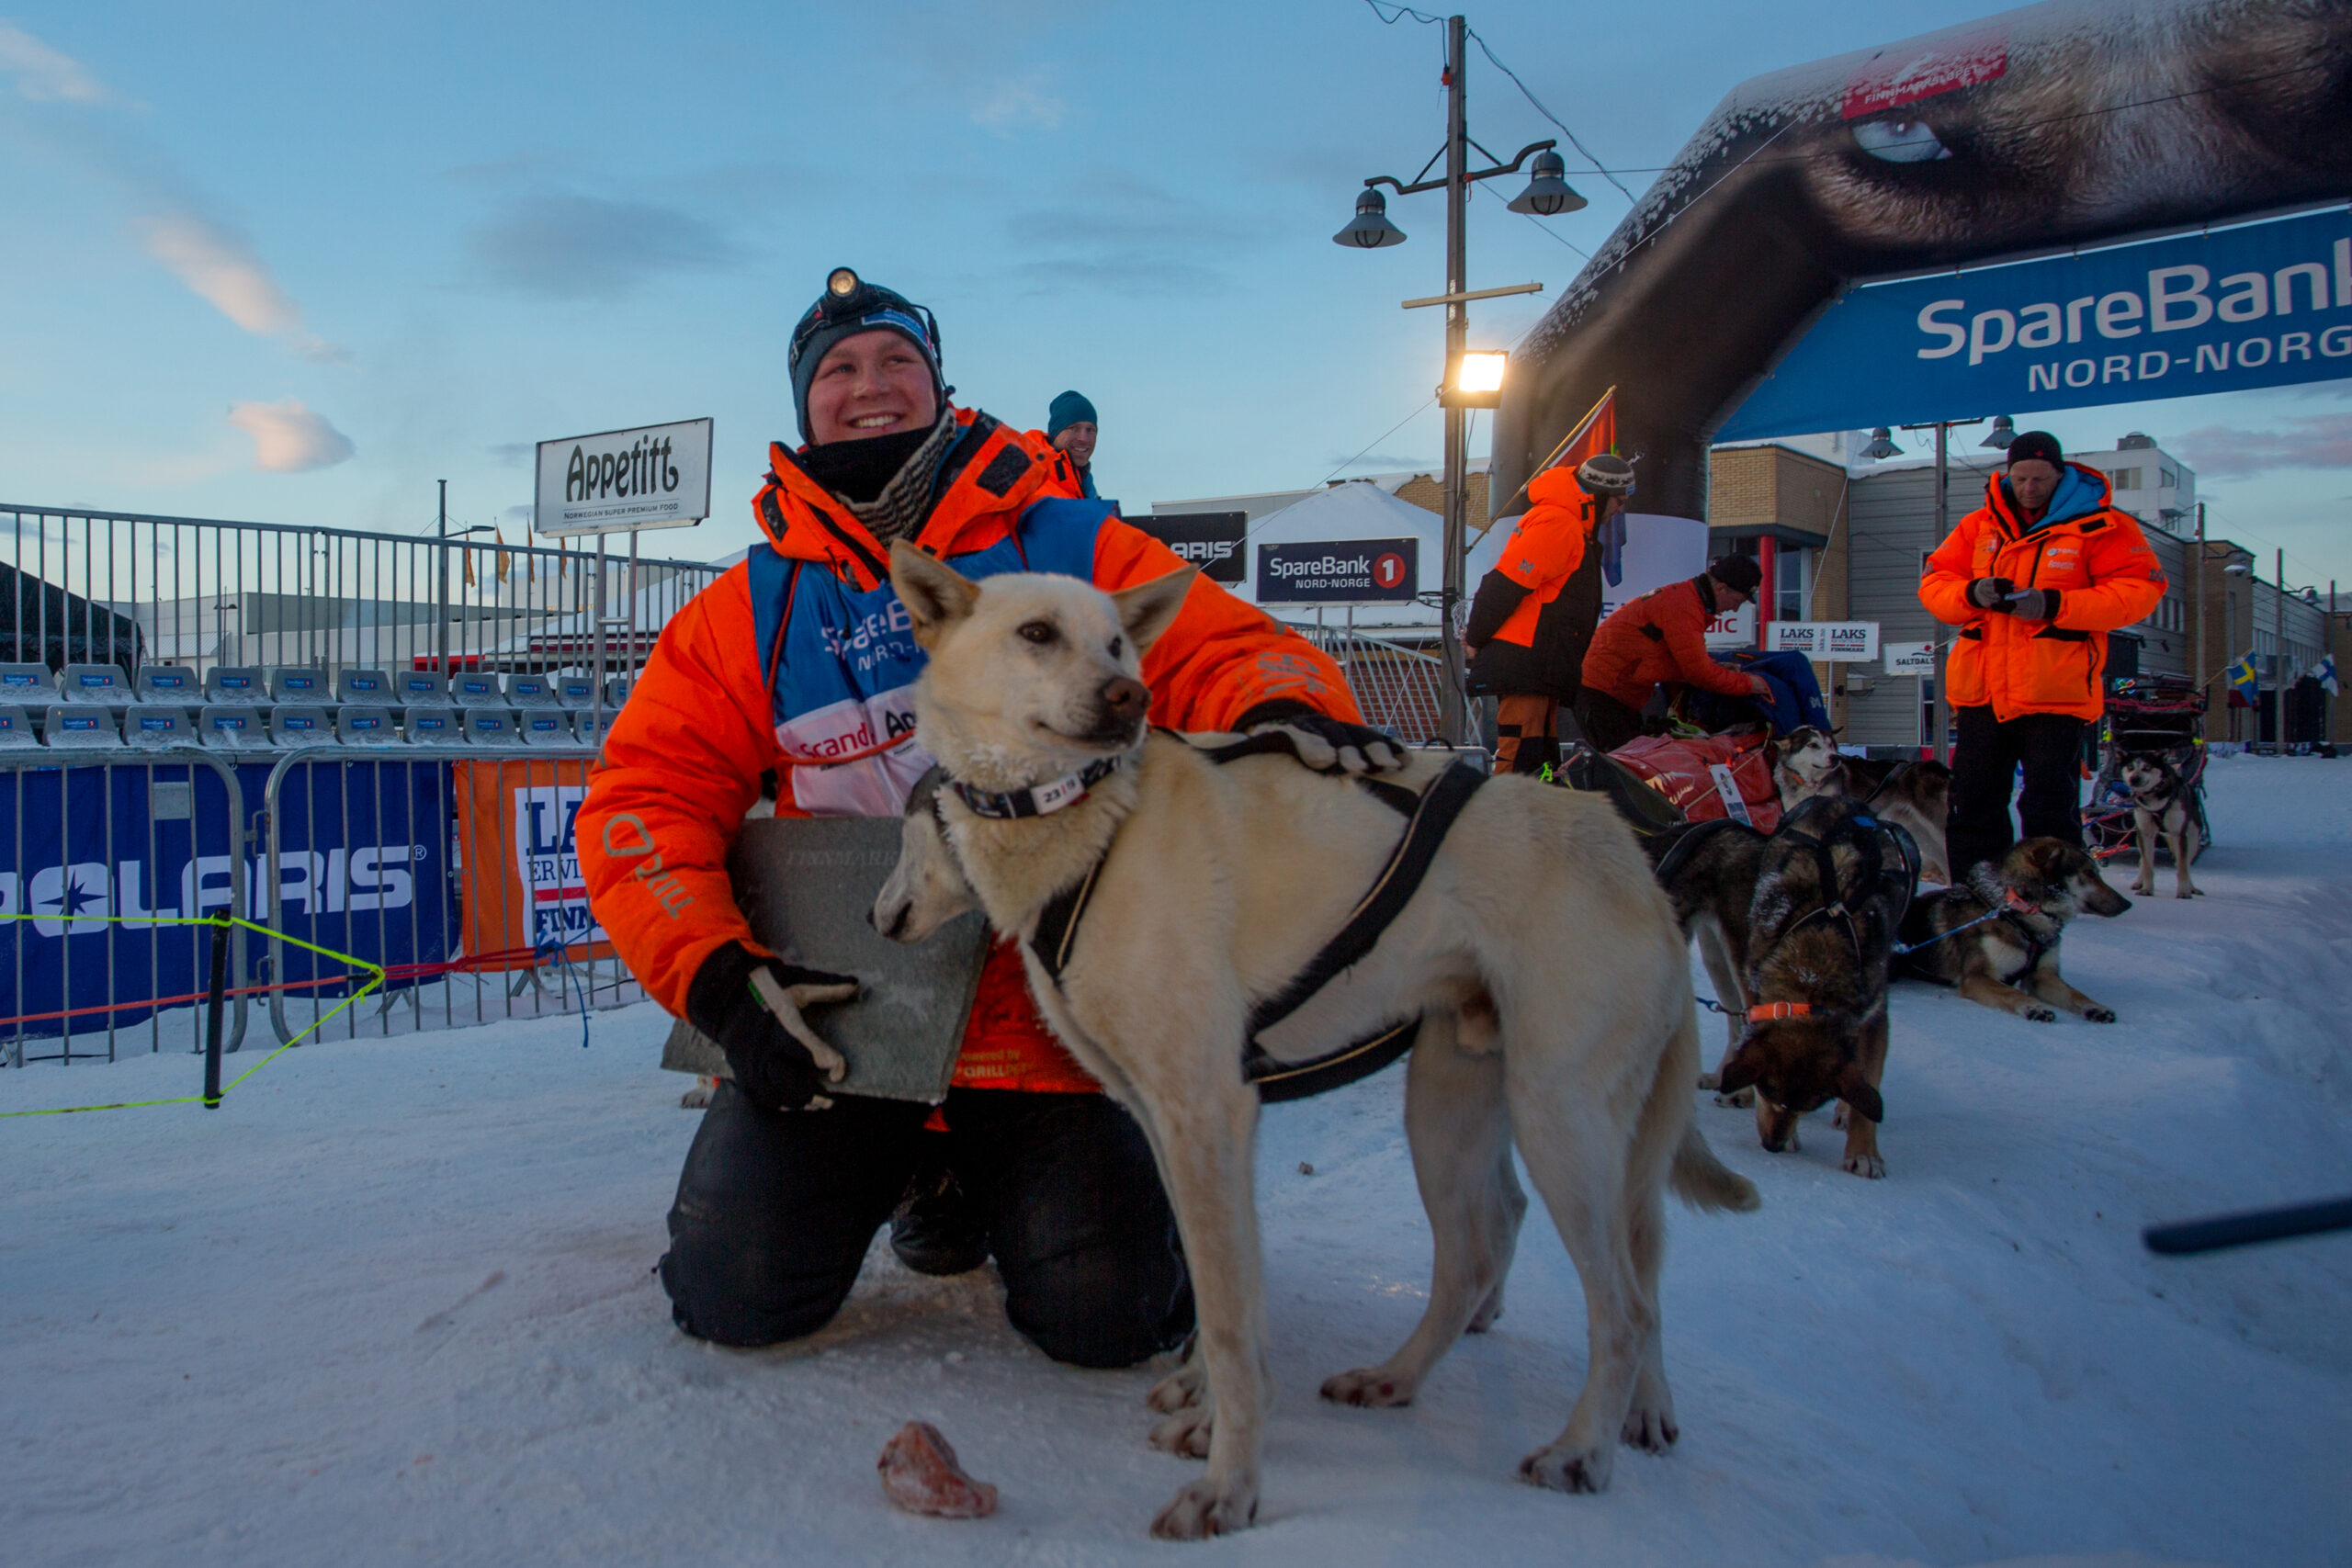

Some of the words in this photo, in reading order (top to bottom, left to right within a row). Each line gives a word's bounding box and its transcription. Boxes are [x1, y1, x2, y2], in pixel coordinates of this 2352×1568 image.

[566, 434, 679, 502] Appetitt
[605, 508, 626, 516] SUPER
[627, 505, 659, 514] PREMIUM
[660, 502, 679, 512] FOOD
[1269, 555, 1371, 579] SpareBank
[1382, 558, 1395, 582] 1
[1295, 578, 1371, 589] NORD-NORGE
[1780, 628, 1815, 639] LAKS
[1831, 628, 1866, 639] LAKS
